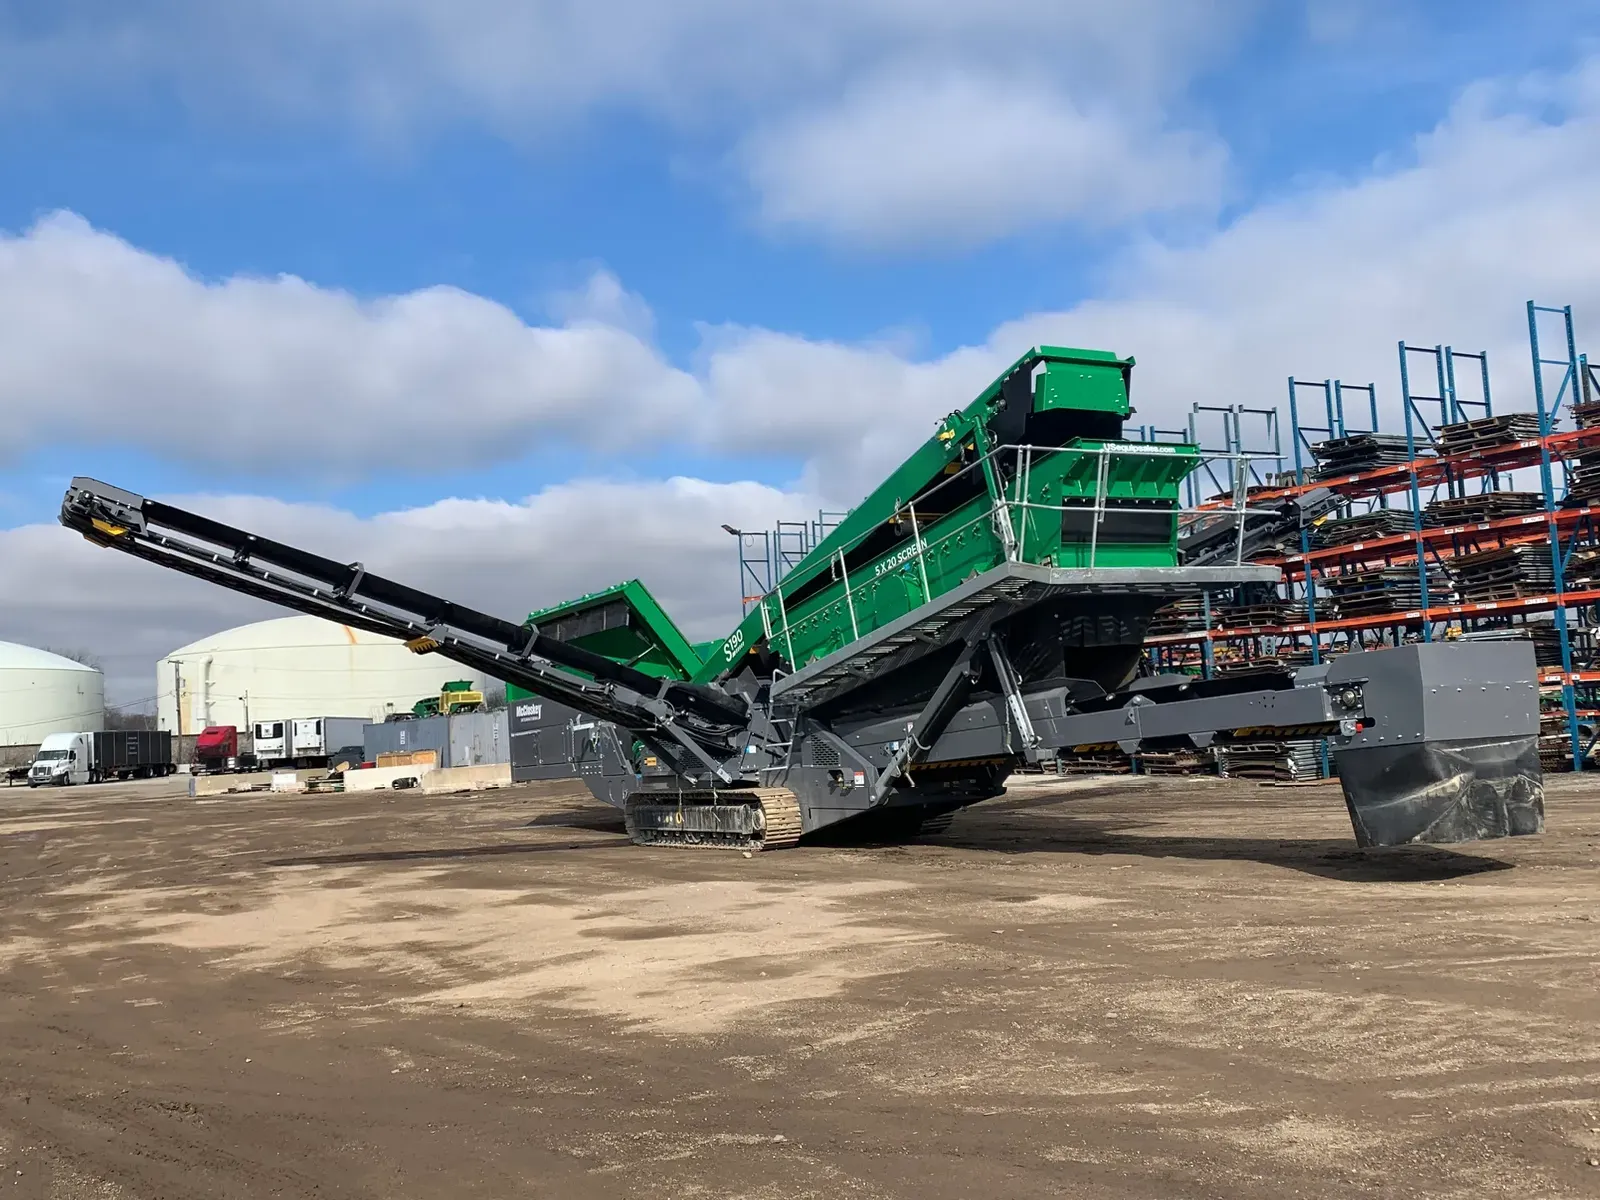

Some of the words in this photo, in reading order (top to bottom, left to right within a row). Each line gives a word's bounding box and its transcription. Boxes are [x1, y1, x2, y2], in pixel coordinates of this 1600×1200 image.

[1103, 443, 1176, 455] USequipsales.com
[875, 565, 881, 576] 5
[880, 561, 887, 573] X
[887, 556, 897, 570] 20
[897, 537, 928, 563] SCREN
[723, 629, 743, 662] S190
